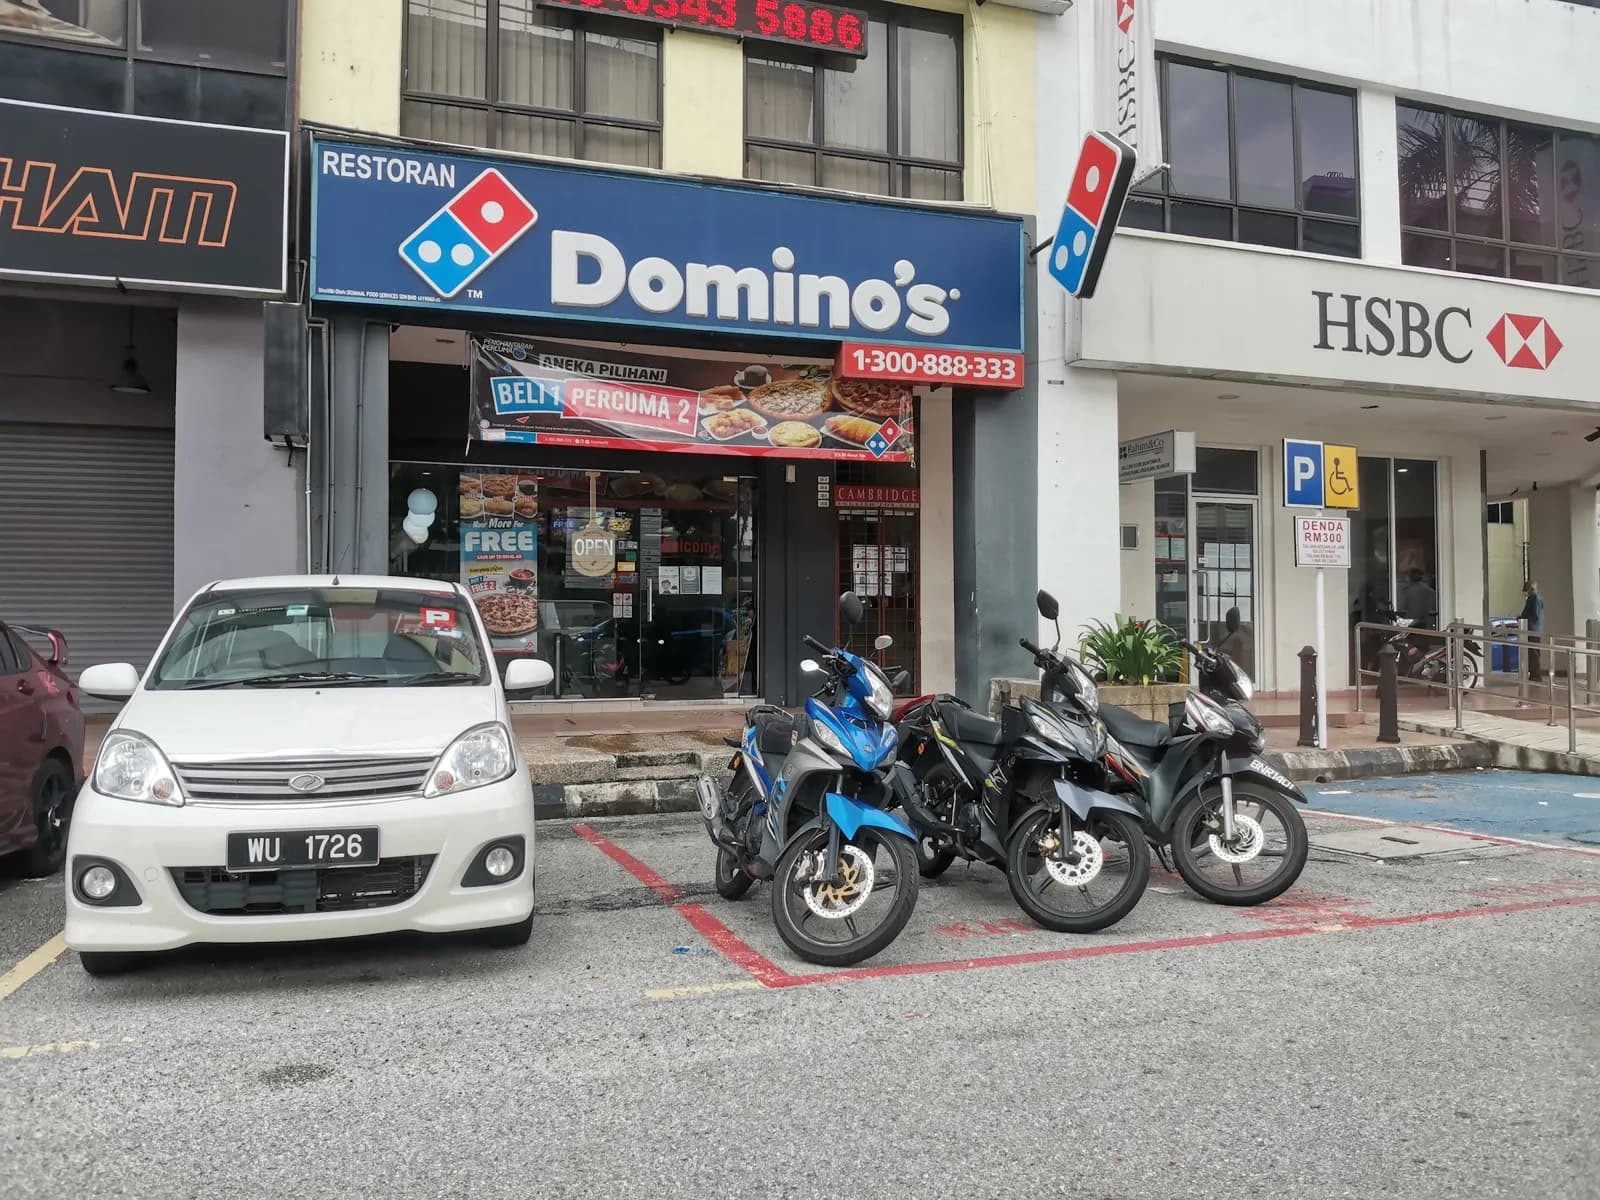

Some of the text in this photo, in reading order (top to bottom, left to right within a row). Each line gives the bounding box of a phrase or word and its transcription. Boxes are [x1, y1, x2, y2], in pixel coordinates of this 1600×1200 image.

[755, 0, 861, 49] 5886
[323, 151, 455, 188] RESTORAN
[467, 290, 483, 298] TM
[551, 230, 950, 336] Domino's
[1311, 290, 1473, 364] HSBC
[543, 356, 664, 381] ANEKA PILIHAN!
[852, 350, 1016, 381] 1-300-888-333
[498, 382, 690, 423] BELI 1 PERCUMA 2
[1294, 456, 1315, 492] P
[838, 488, 918, 502] CAMBRIDGE
[488, 518, 512, 529] More
[1302, 520, 1343, 532] DENDA
[465, 531, 534, 552] FREE
[574, 538, 614, 556] OPEN
[1304, 532, 1342, 543] RM300
[426, 610, 450, 624] P
[248, 834, 362, 863] WU 1726
